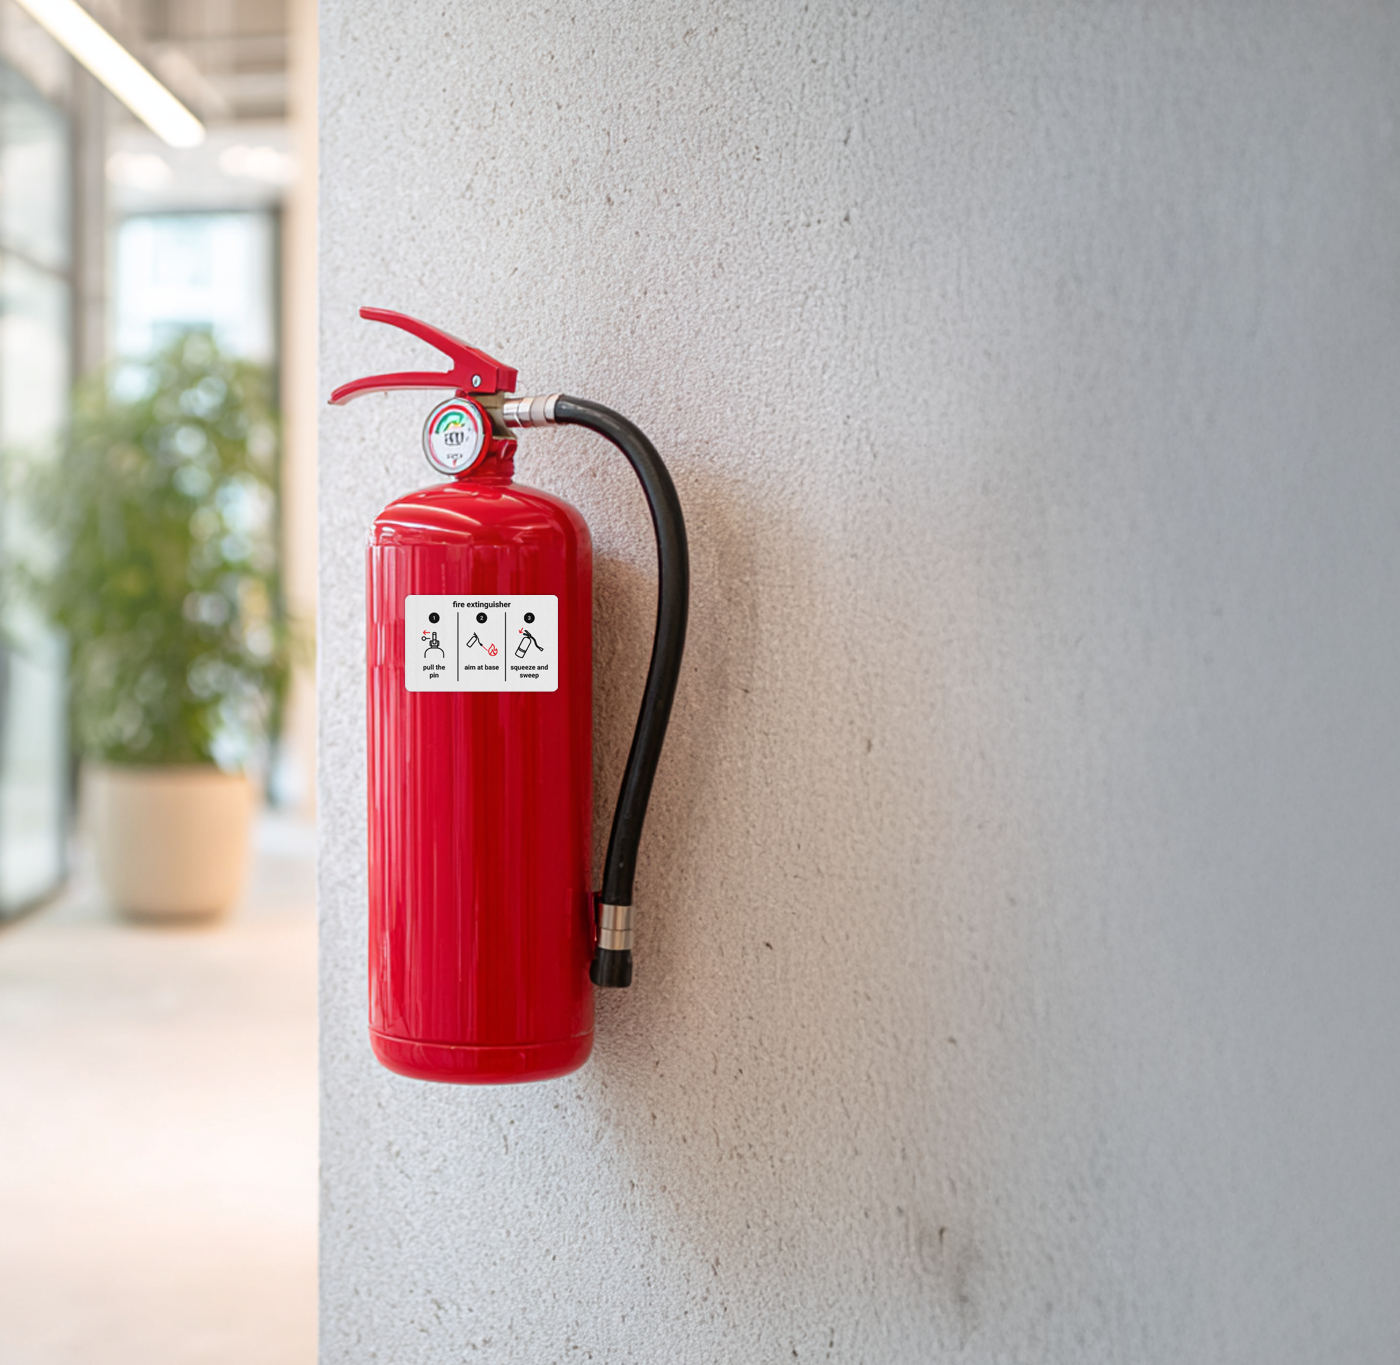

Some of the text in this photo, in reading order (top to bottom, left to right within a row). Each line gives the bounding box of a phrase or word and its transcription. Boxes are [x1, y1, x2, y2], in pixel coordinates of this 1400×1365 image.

[452, 600, 511, 609] fire extinguisher
[423, 664, 435, 672] pull
[429, 672, 440, 680] pin
